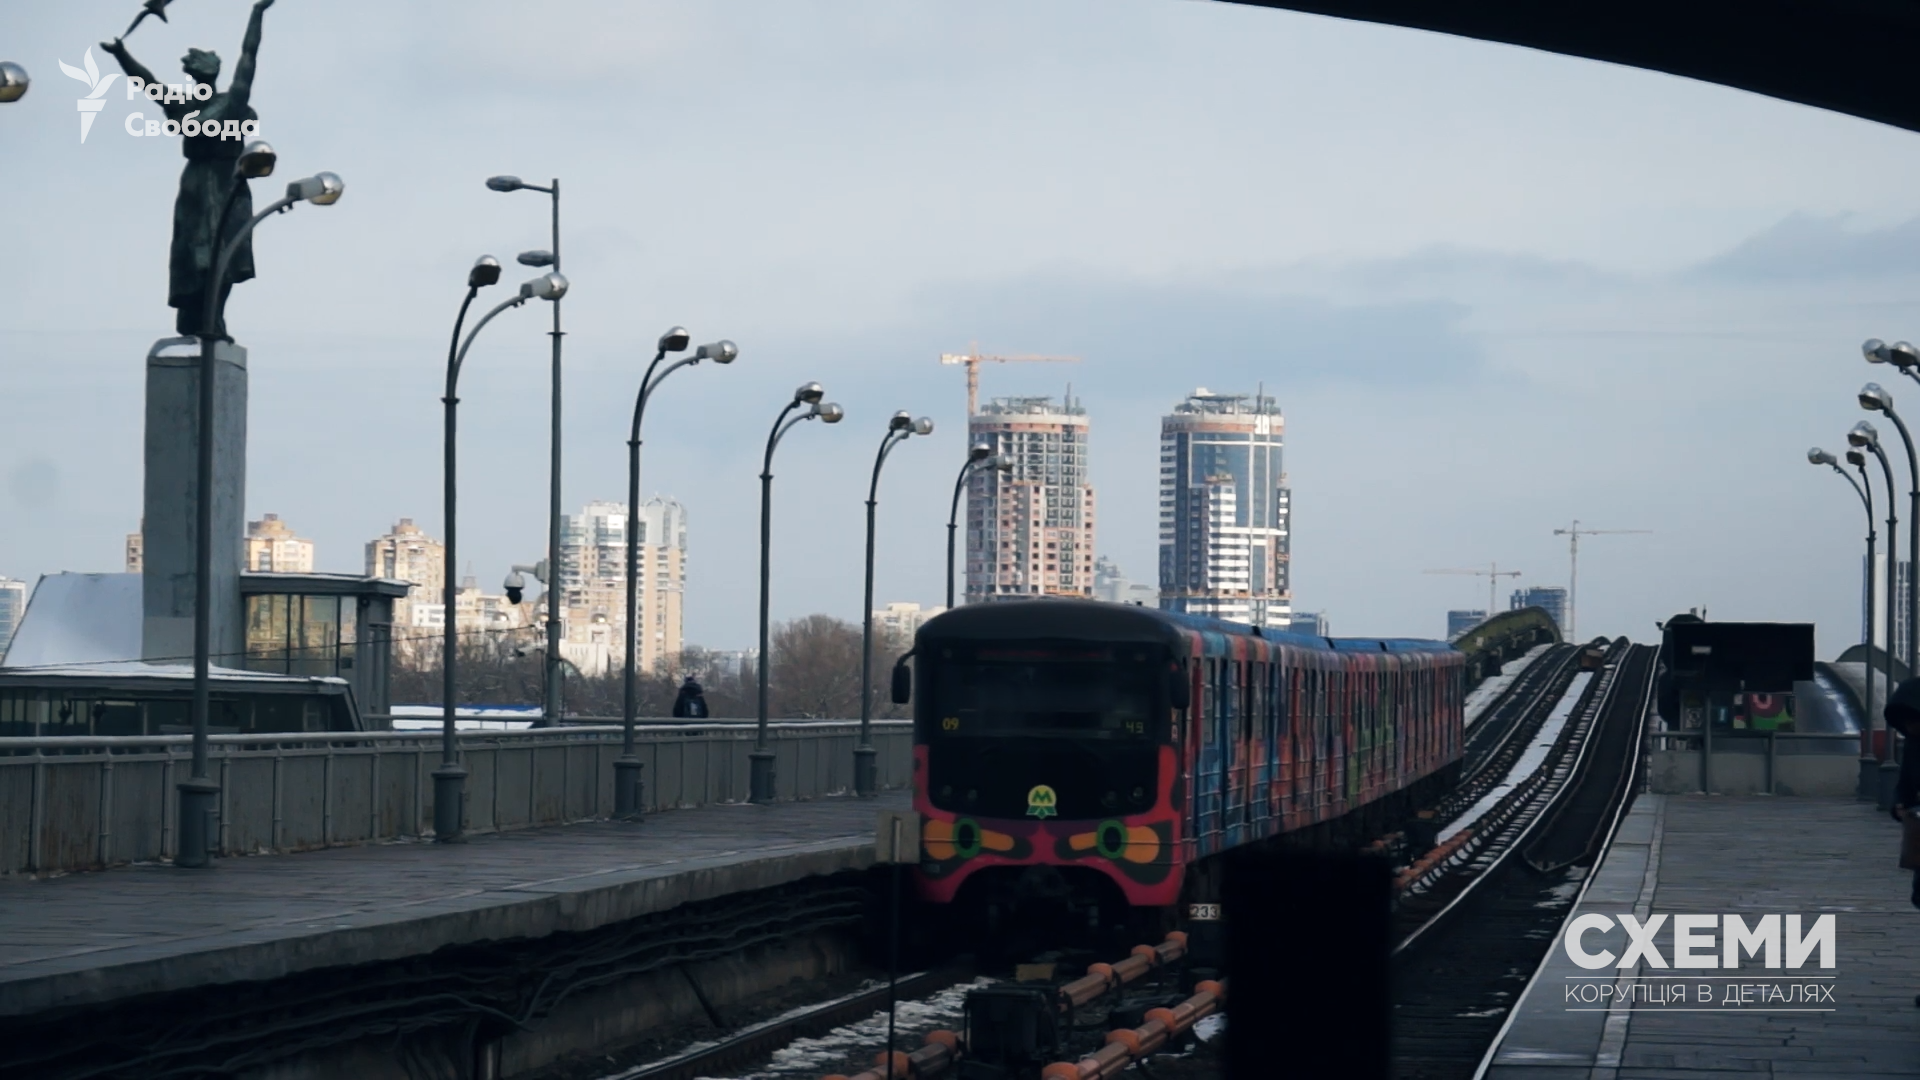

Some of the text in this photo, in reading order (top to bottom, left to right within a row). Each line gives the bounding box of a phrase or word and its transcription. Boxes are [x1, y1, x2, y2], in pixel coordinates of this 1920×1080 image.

[942, 717, 960, 731] 09
[1125, 721, 1145, 734] 49
[1189, 905, 1218, 919] 233
